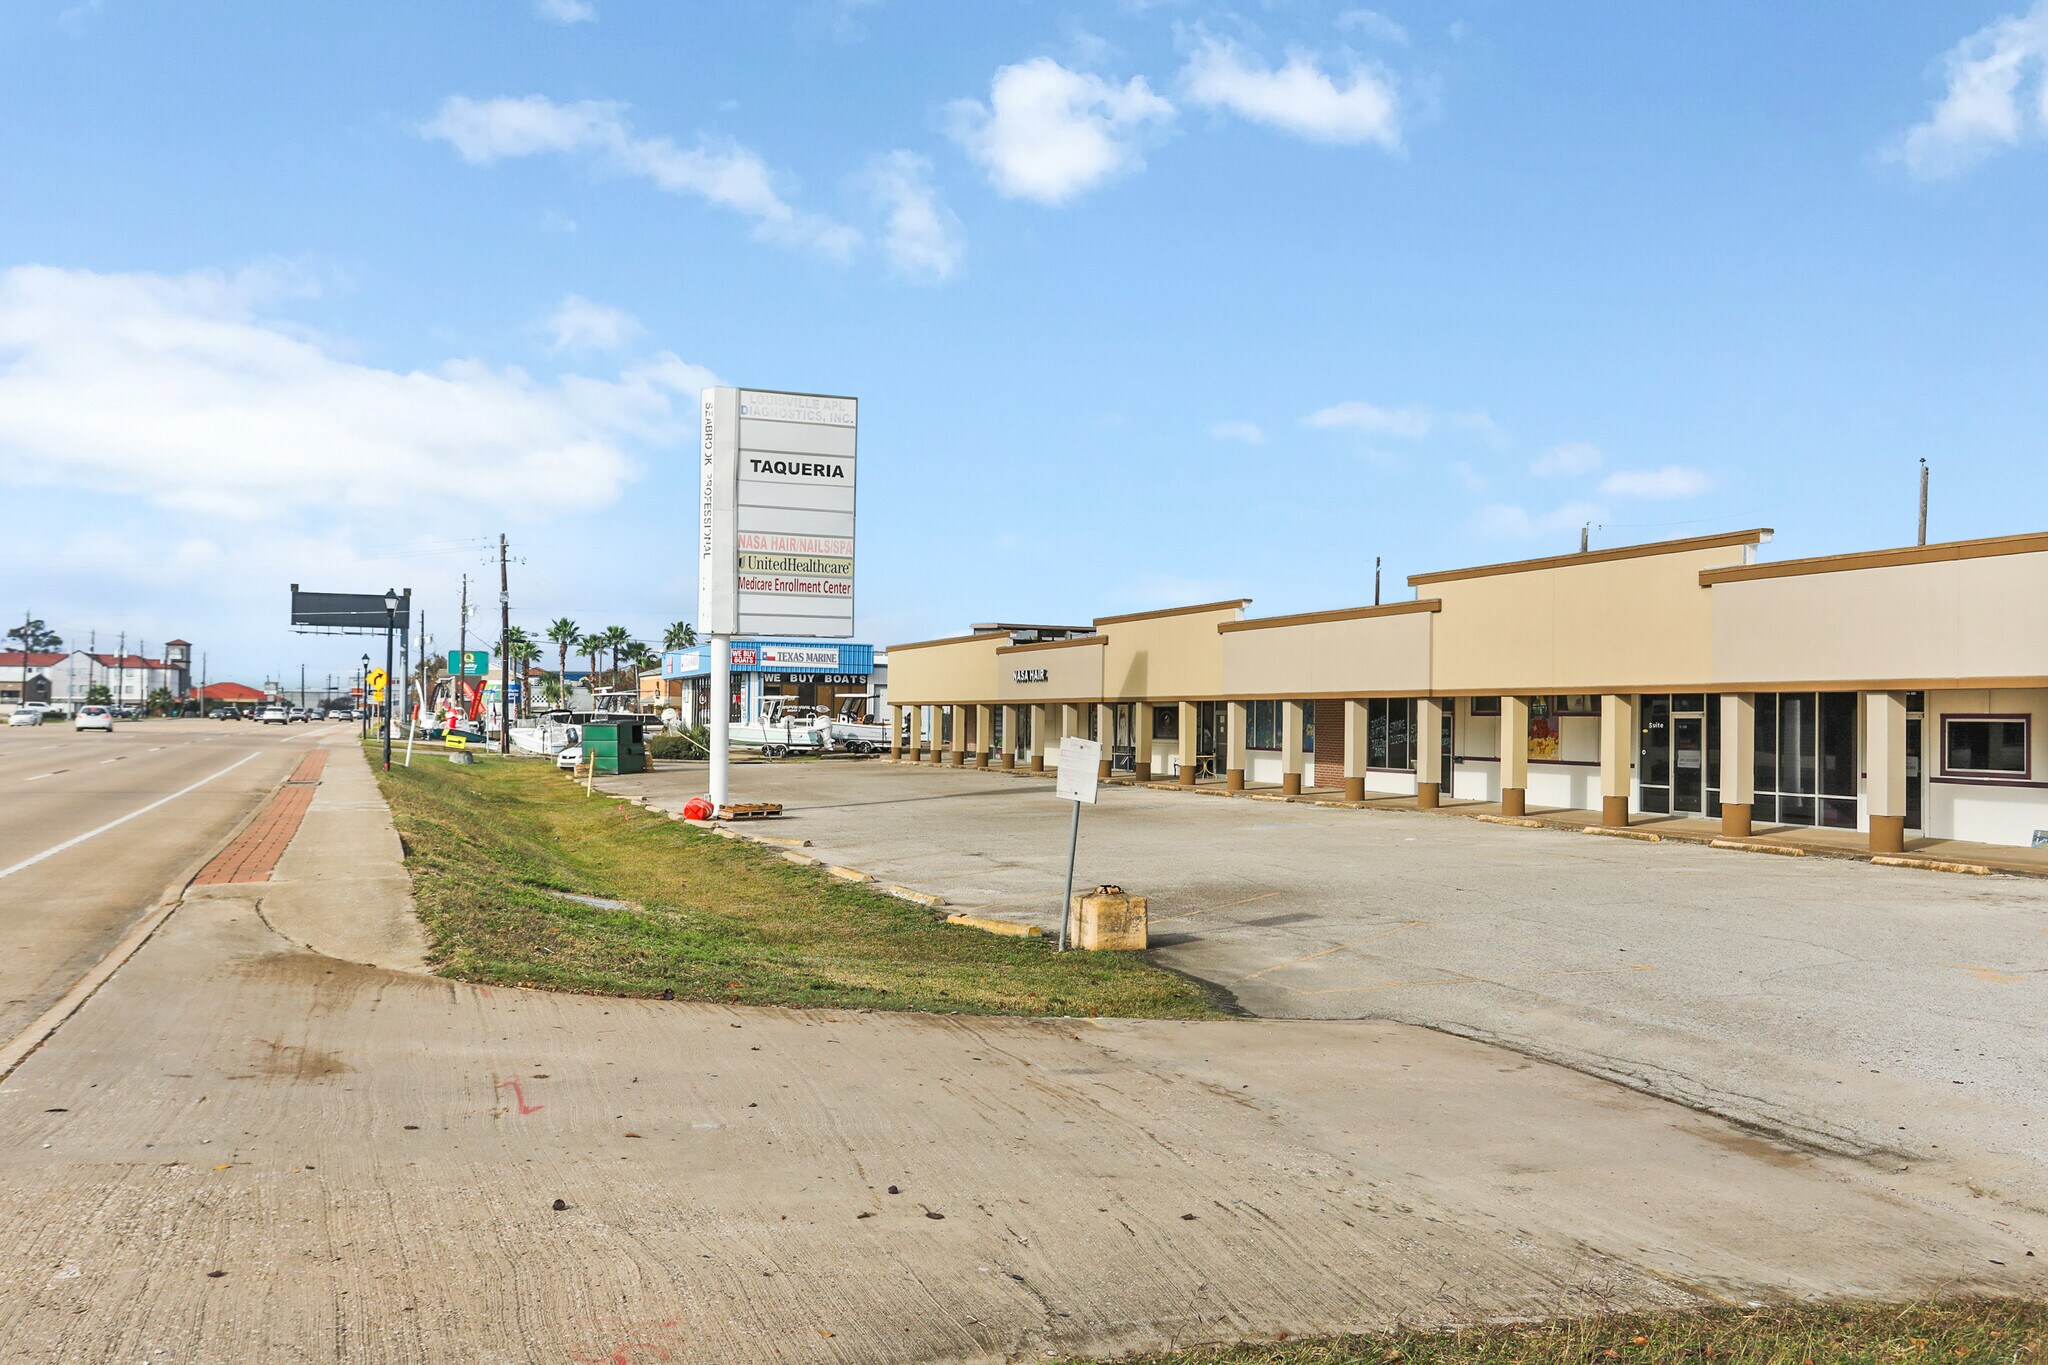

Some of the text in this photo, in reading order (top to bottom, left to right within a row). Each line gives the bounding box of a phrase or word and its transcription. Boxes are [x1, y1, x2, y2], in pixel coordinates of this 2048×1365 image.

[749, 394, 846, 411] LOUISVILLE APL
[829, 412, 854, 424] INC.
[750, 459, 844, 478] TAQUERIA
[737, 534, 853, 555] NASA HAIR/NAILS/SPA
[738, 576, 851, 595] Medicare Enrollment Center
[734, 656, 754, 664] BOATS
[777, 651, 837, 663] TEXAS MARINE
[764, 673, 867, 684] WE BUY BOATS
[1013, 668, 1045, 681] NASA HAIR
